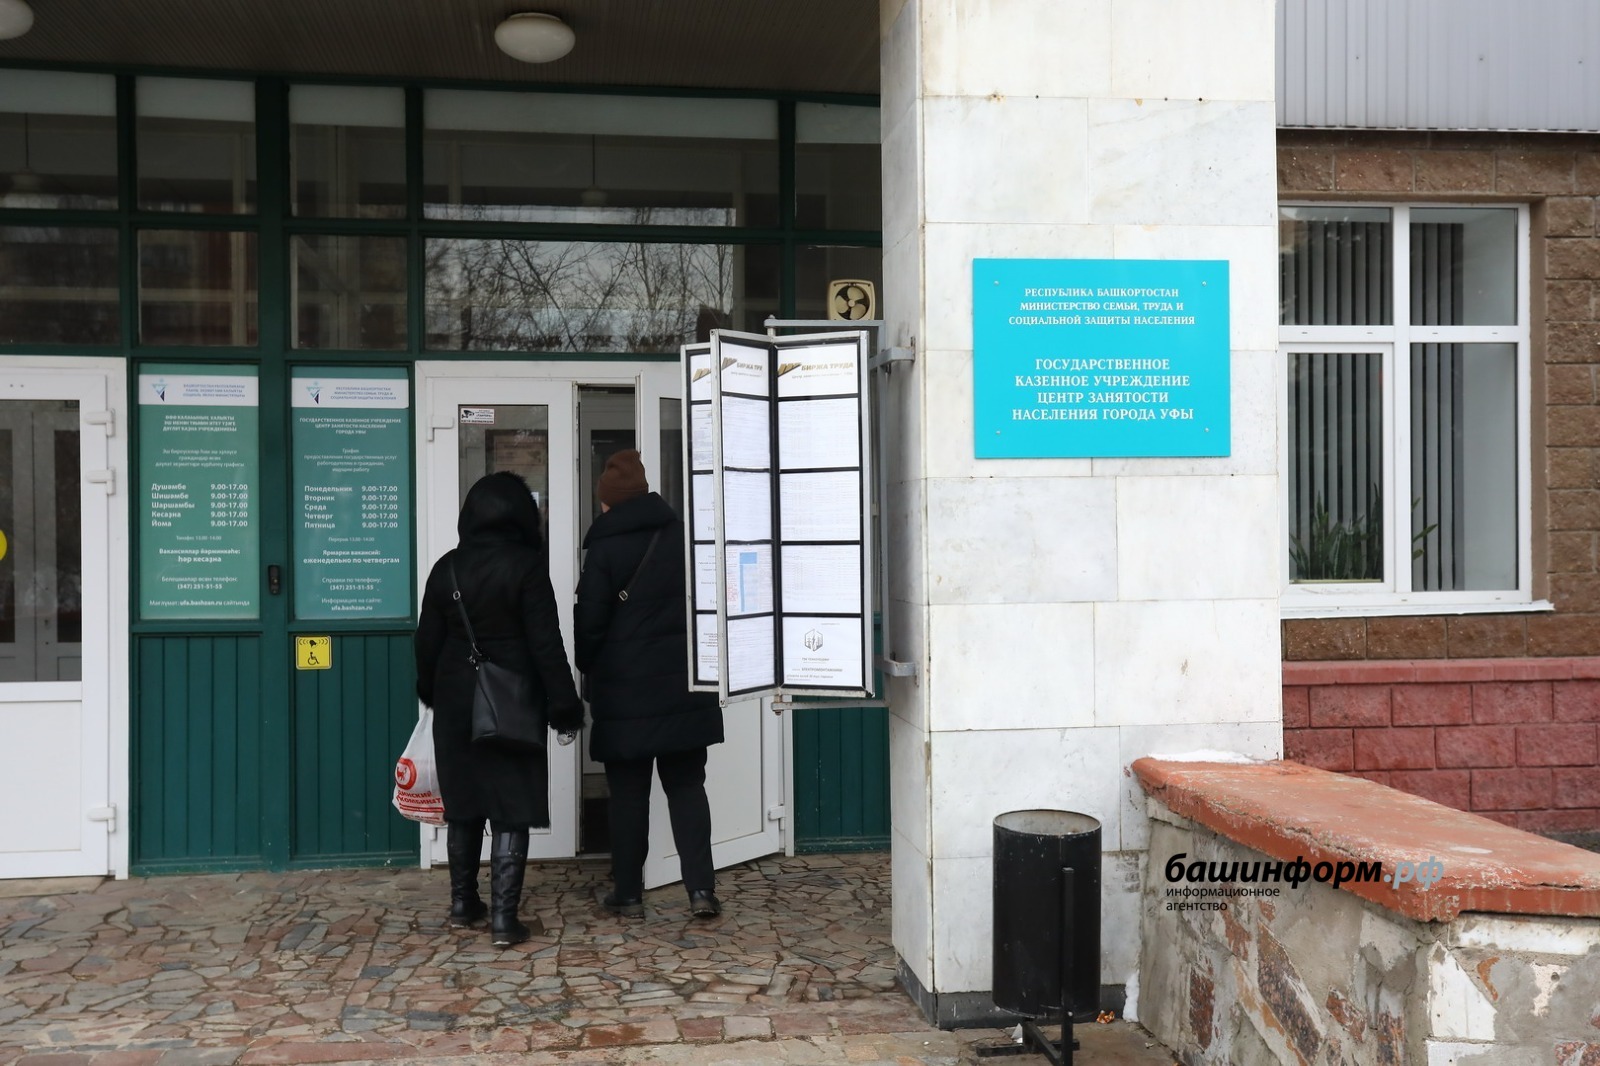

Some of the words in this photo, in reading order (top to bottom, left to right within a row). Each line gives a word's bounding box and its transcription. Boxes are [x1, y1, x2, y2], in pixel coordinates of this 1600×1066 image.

[1024, 288, 1094, 297] РЕСПУБЛИКА
[1097, 288, 1179, 297] БАШКОРТОСТАН
[1020, 302, 1100, 311] МИНИСТЕРСТВО
[1103, 302, 1140, 311] СЕМЬИ,
[1143, 302, 1173, 311] ТРУДА
[1176, 302, 1183, 311] И
[1008, 315, 1081, 326] СОЦИАЛЬНОЙ
[1084, 316, 1131, 326] ЗАЩИТЫ
[1134, 316, 1195, 325] НАСЕЛЕНИЯ
[1035, 359, 1170, 370] ГОСУДАРСТВЕННОЕ
[1014, 375, 1089, 387] КАЗЕННОЕ
[1094, 375, 1190, 387] УЧРЕЖДЕНИЕ
[1037, 392, 1084, 405] ЦЕНТР
[1088, 392, 1169, 403] ЗАНЯТОСТИ
[1012, 409, 1098, 420] НАСЕЛЕНИЯ
[1102, 409, 1156, 421] ГОРОДА
[1160, 408, 1194, 419] УФЫ
[304, 485, 353, 493] Понедельник
[151, 502, 195, 510] Шаршамбы
[151, 519, 172, 527] Йома
